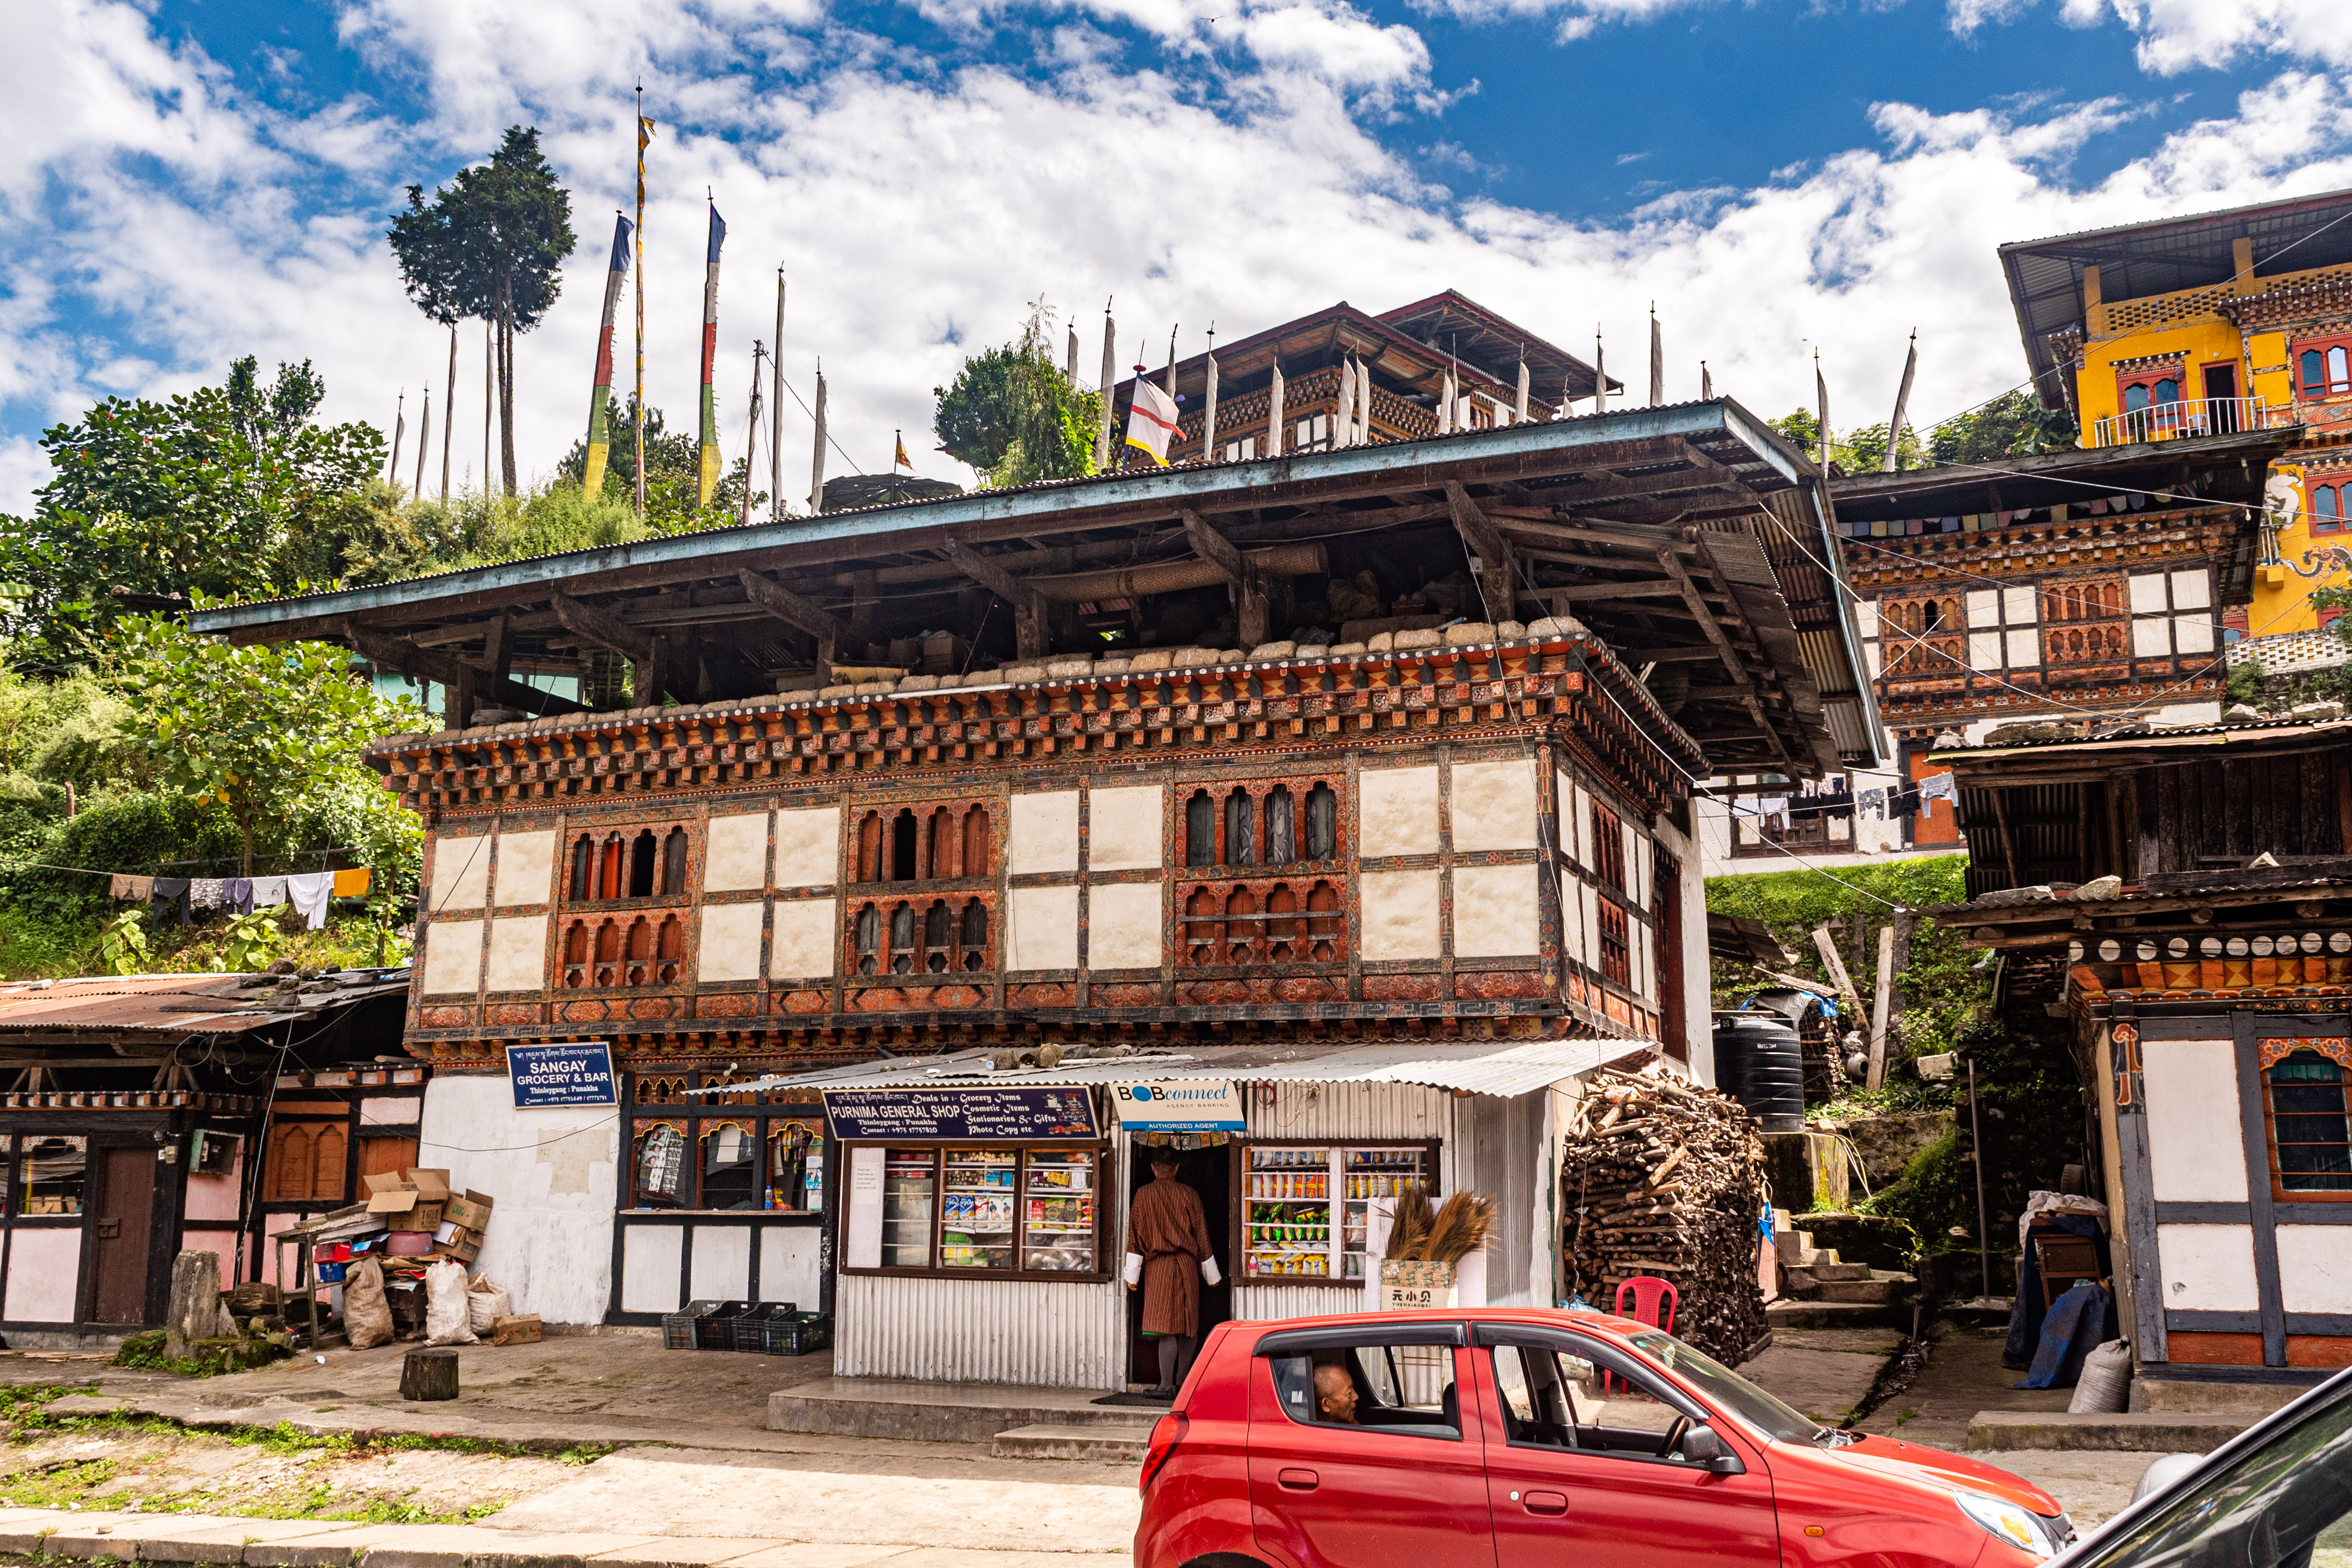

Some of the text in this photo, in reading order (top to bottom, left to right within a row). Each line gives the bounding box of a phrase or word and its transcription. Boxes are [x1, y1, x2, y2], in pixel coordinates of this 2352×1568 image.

[530, 1060, 587, 1074] SANGAY
[517, 1073, 608, 1085] GROCERY & BAR
[912, 1094, 938, 1104] Deals
[960, 1094, 991, 1104] Grocery
[994, 1093, 1021, 1104] Items
[831, 1105, 960, 1118] PURNIMA GENERAL SHOP
[962, 1104, 1030, 1114] Cosmetic Items
[966, 1114, 1056, 1125] Stationaries & Gifts
[967, 1125, 993, 1135] Photo
[996, 1125, 1018, 1135] Copy
[1392, 1290, 1431, 1303] 元小贝
